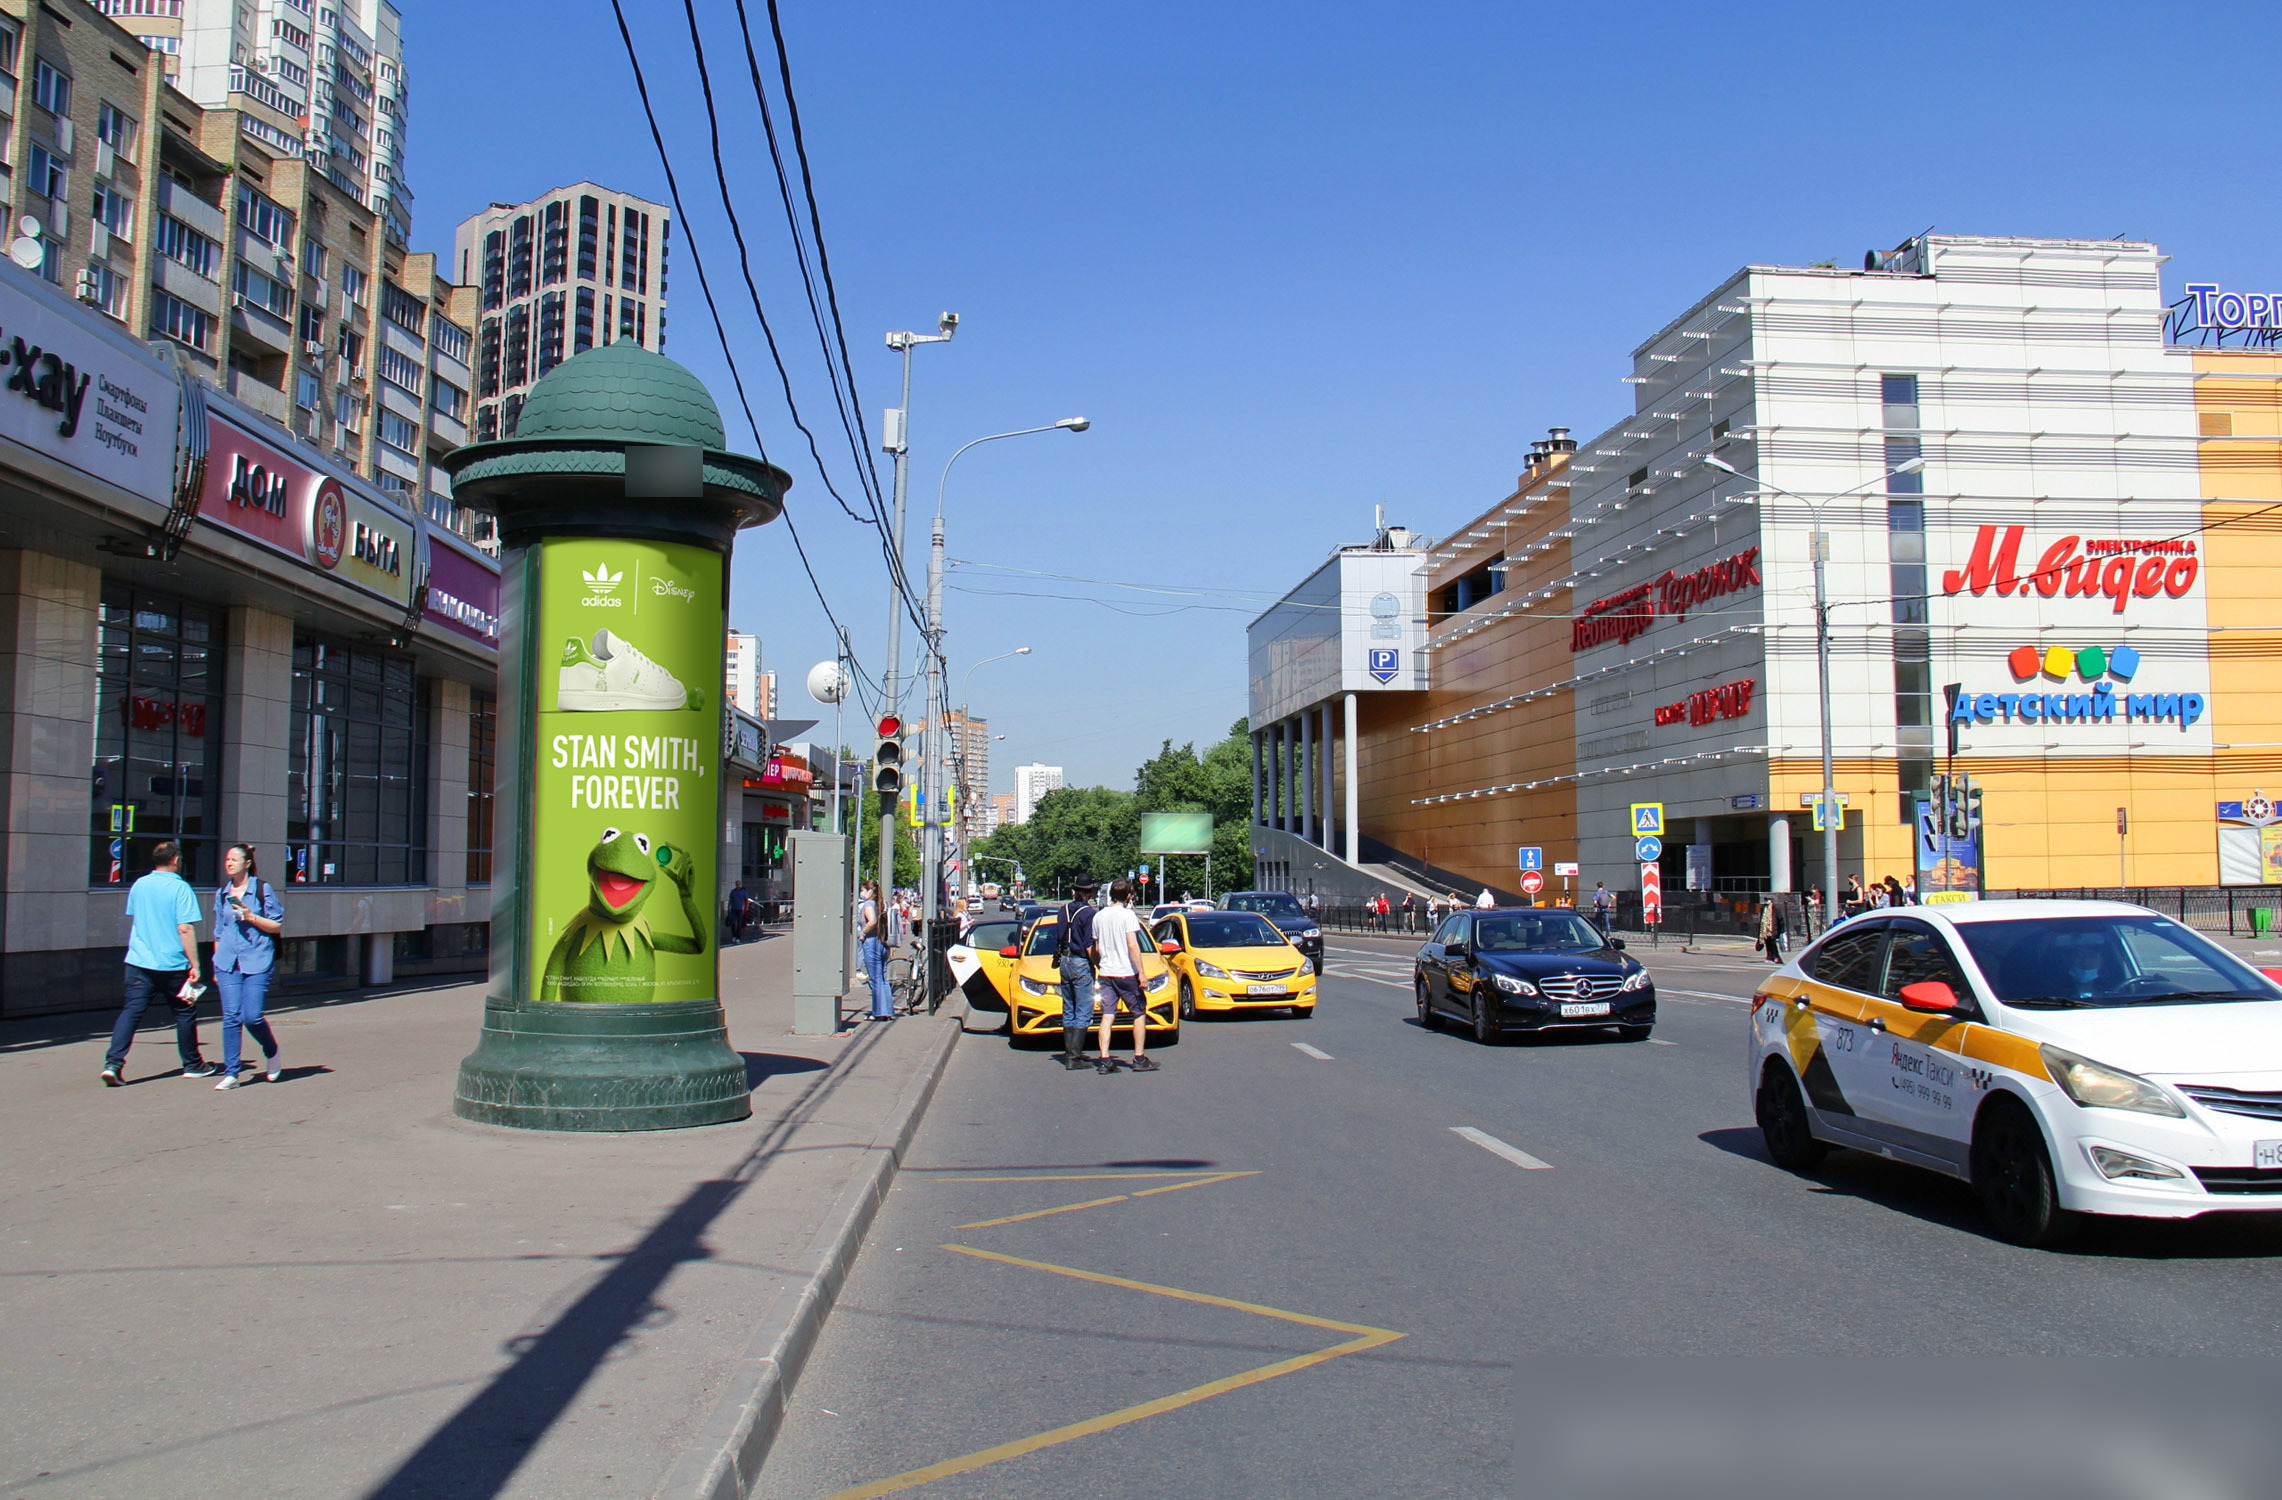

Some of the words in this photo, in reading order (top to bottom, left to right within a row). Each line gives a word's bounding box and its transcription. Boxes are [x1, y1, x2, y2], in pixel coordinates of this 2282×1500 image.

[99, 373, 148, 414] Смартфоны
[97, 398, 143, 435] Планшеты
[95, 421, 138, 458] Ноутбуки
[225, 453, 286, 518] ДОМ
[351, 521, 401, 577] БЫТА
[2086, 539, 2197, 555] ЭЛЕКТРОНИКА
[1655, 546, 1762, 622] Теремок
[1943, 525, 2198, 614] М.видео
[581, 595, 622, 607] adidas
[1570, 600, 1654, 652] Леонардо
[1378, 652, 1391, 667] P
[1952, 682, 2117, 722] детский
[2128, 693, 2204, 726] мир
[552, 735, 616, 768] STAN
[624, 736, 705, 778] SMITH,
[572, 775, 680, 810] FOREVER
[1934, 894, 1966, 904] ТАКСИ
[1836, 1027, 1854, 1052] 873
[1891, 1042, 1923, 1075] Яндекс
[1925, 1054, 1953, 1088] Такси
[1917, 1084, 1930, 1101] 999
[1932, 1090, 1941, 1106] 99
[1943, 1095, 1952, 1110] 99
